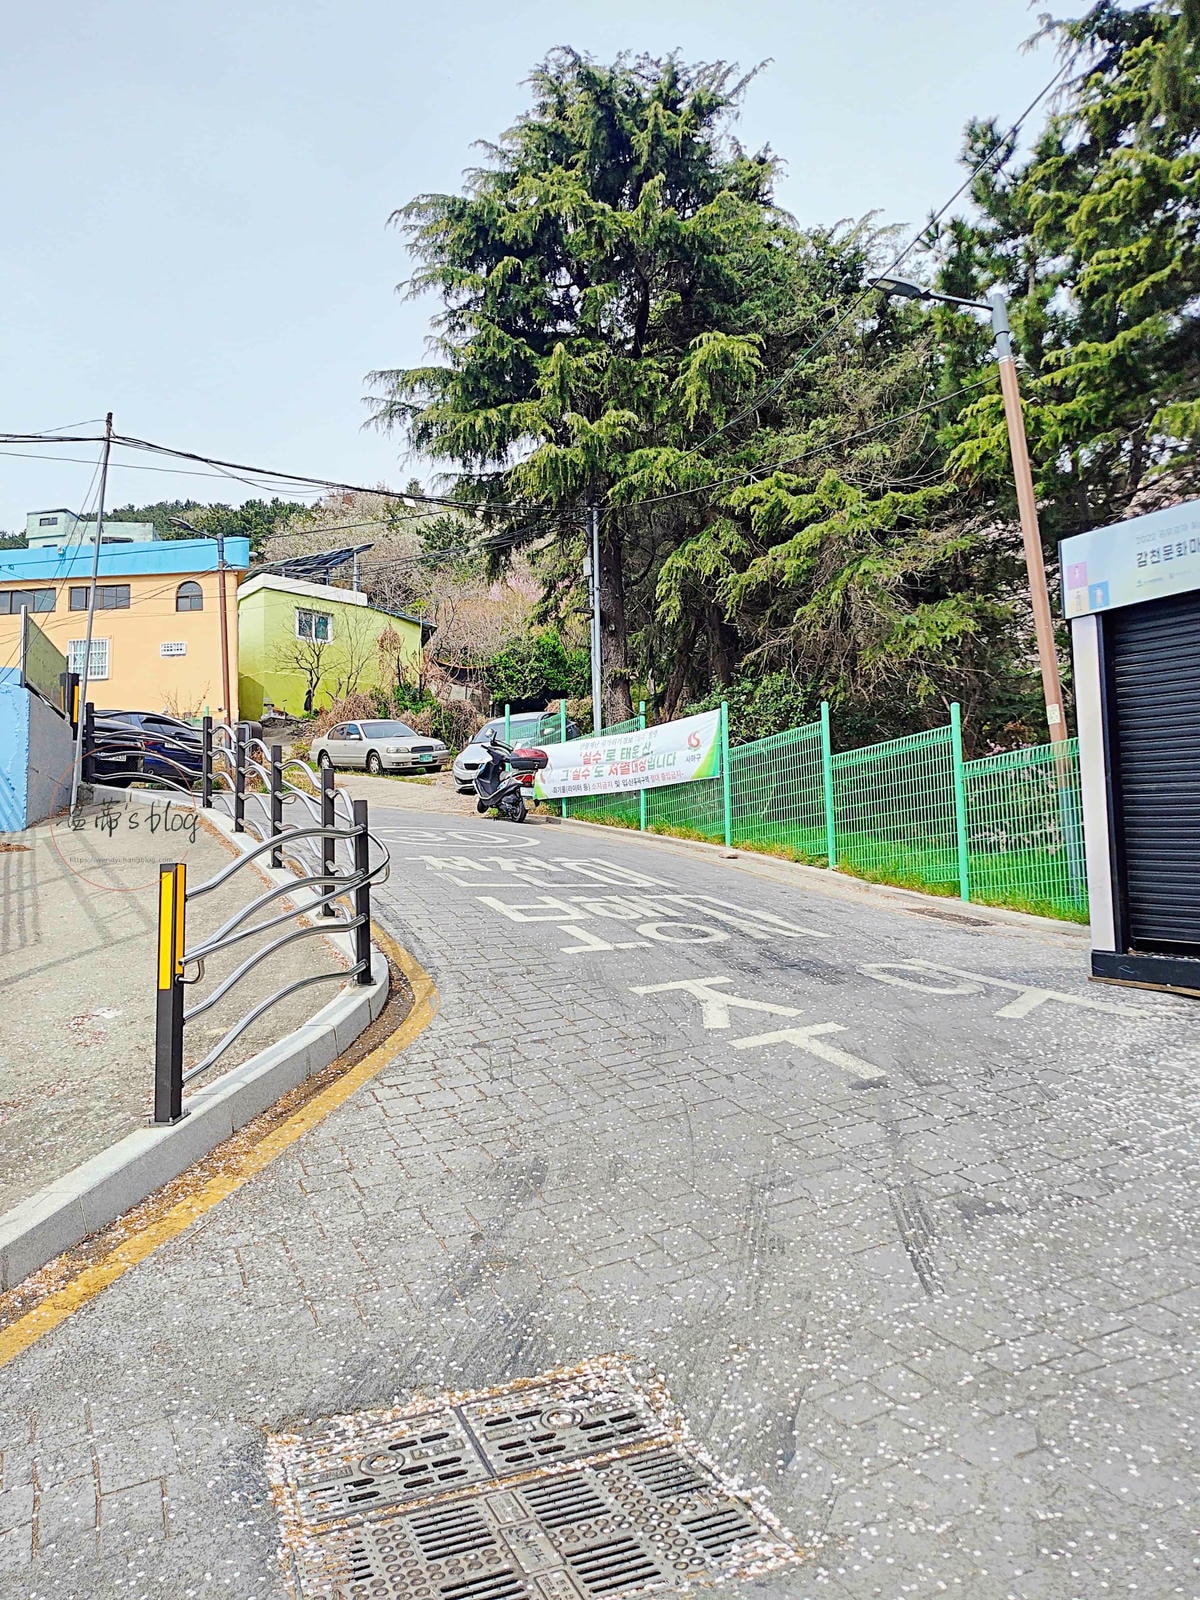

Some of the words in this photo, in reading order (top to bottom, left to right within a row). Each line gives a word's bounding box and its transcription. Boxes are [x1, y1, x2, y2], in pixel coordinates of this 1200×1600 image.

[580, 748, 616, 765] '실수'로
[686, 754, 701, 764] 사하구
[560, 770, 569, 782] 그
[381, 829, 510, 844] 30
[404, 855, 679, 888] 천천히
